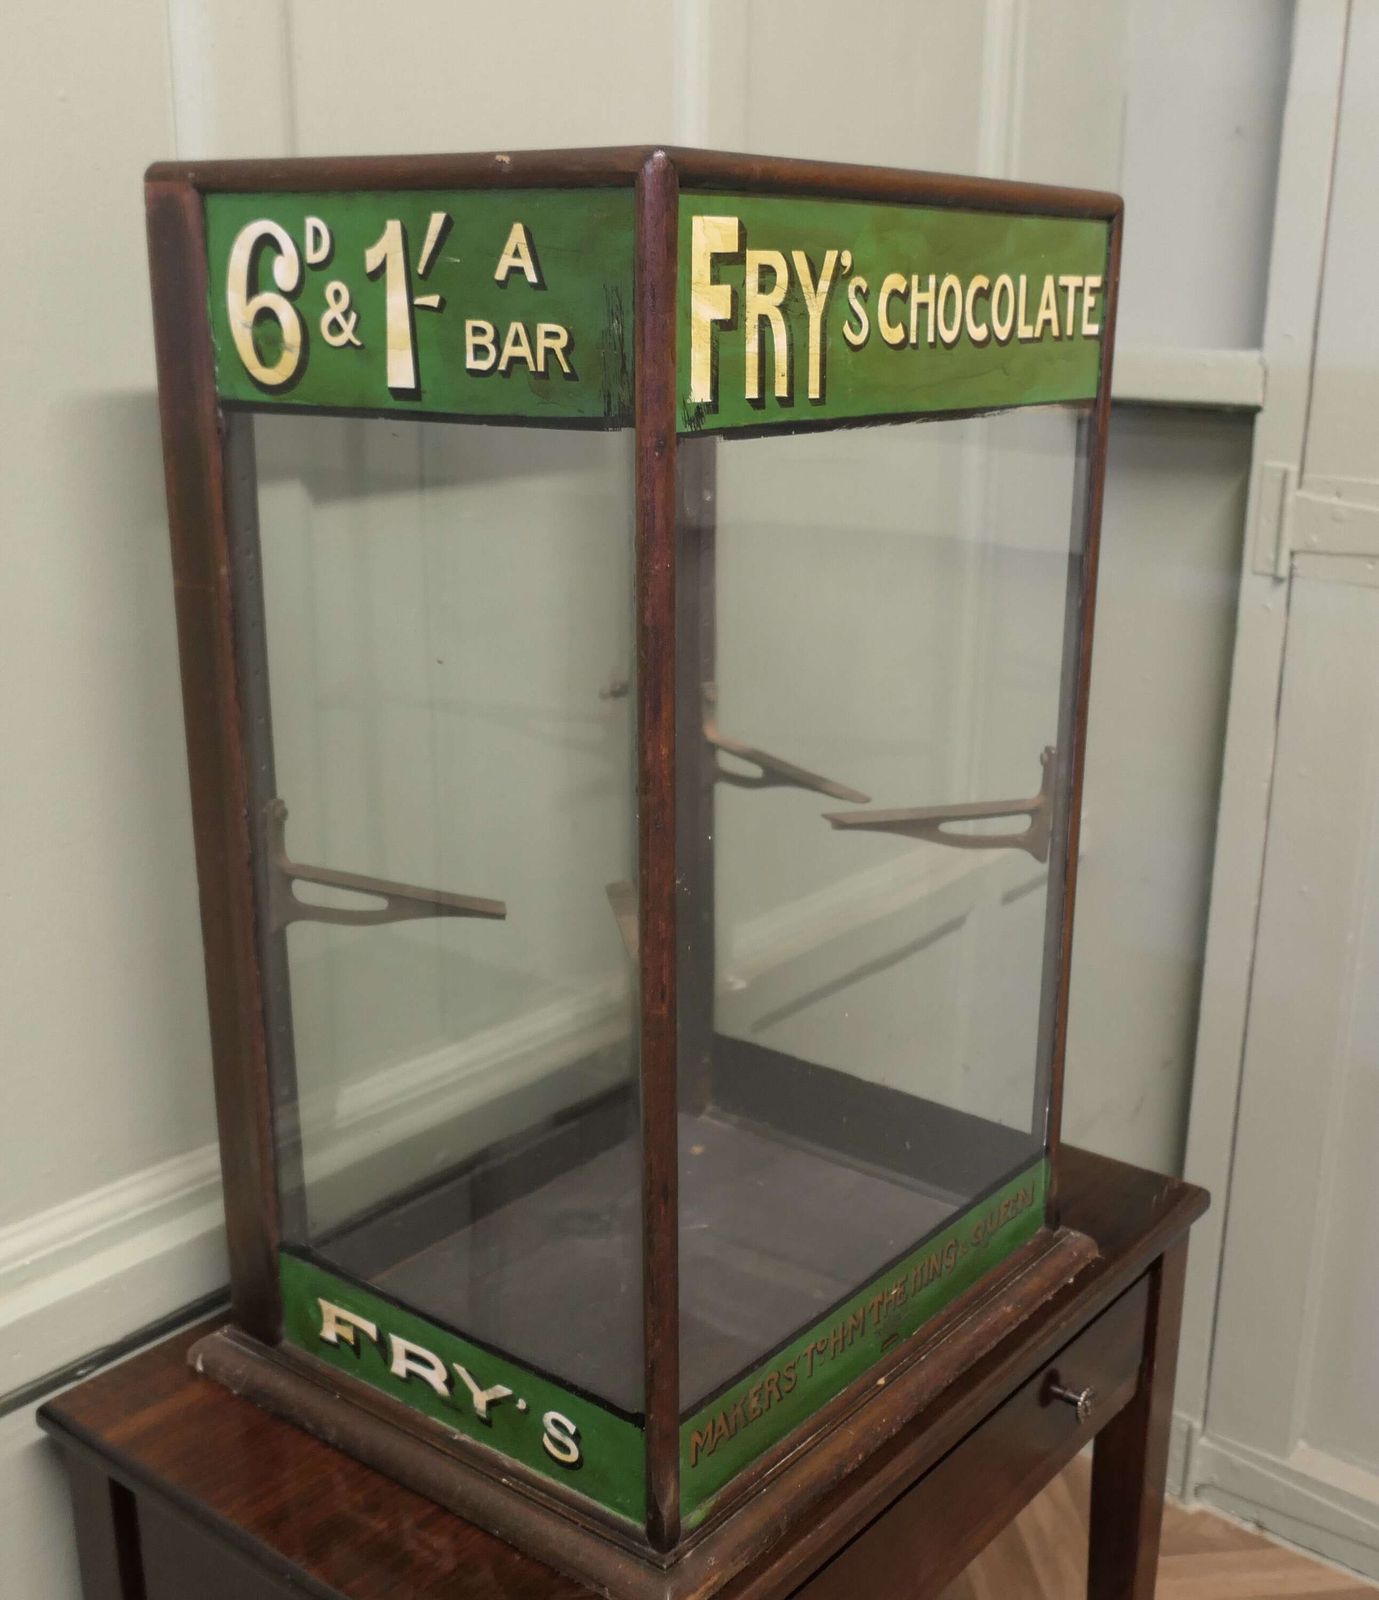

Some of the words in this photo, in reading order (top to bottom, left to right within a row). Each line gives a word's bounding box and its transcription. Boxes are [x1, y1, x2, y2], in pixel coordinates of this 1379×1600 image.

[493, 222, 539, 284] A
[320, 280, 362, 348] &
[689, 215, 871, 404] FRY'S
[877, 272, 1102, 346] CHOCOLATE
[464, 318, 573, 375] BAR
[317, 1296, 580, 1464] FRY'S
